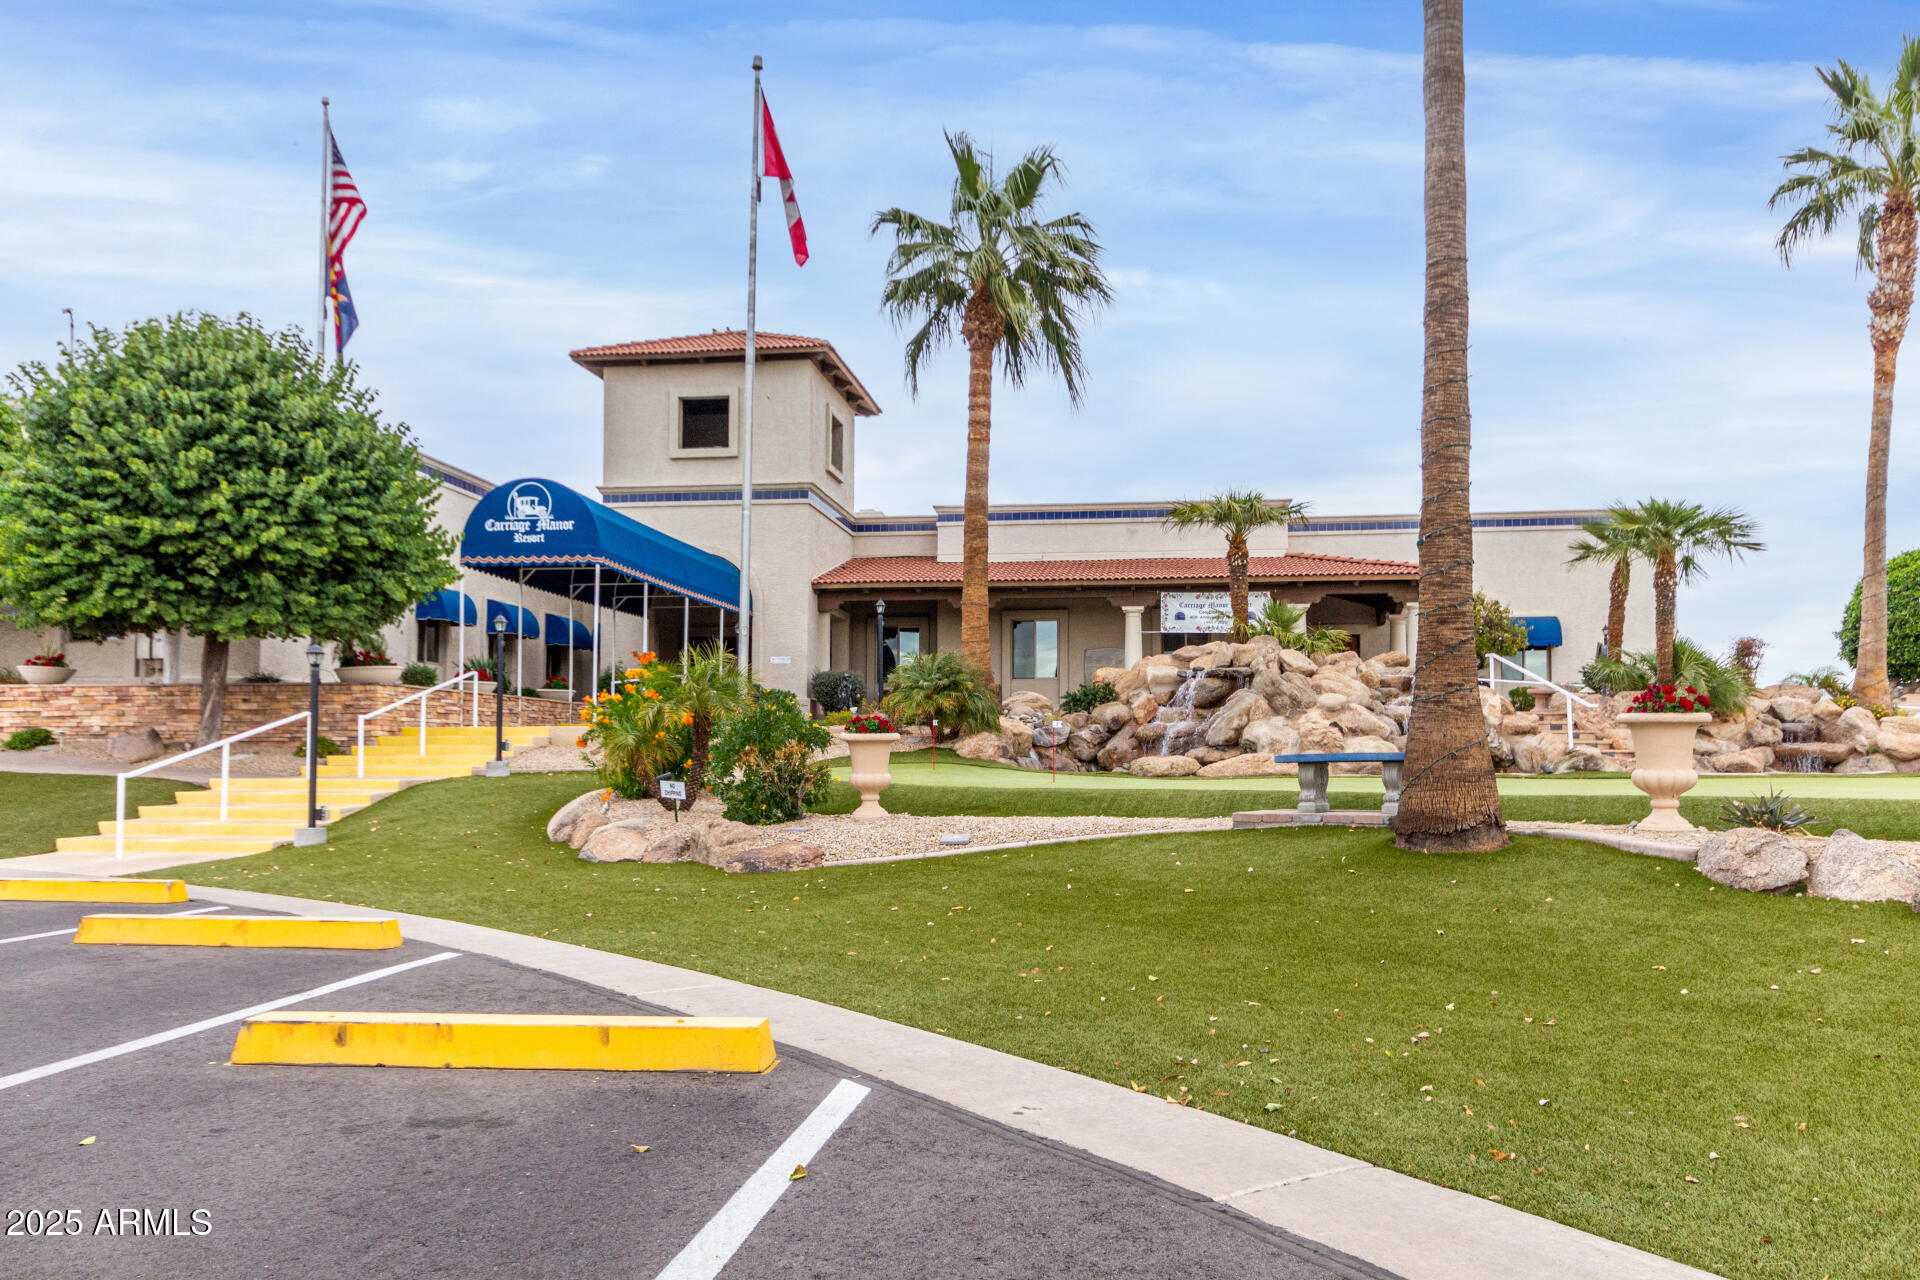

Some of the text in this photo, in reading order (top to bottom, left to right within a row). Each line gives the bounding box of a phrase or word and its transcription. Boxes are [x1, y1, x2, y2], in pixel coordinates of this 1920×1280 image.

[484, 518, 575, 532] Carriage Manor
[513, 532, 545, 543] Resort
[1178, 601, 1206, 609] Carriage
